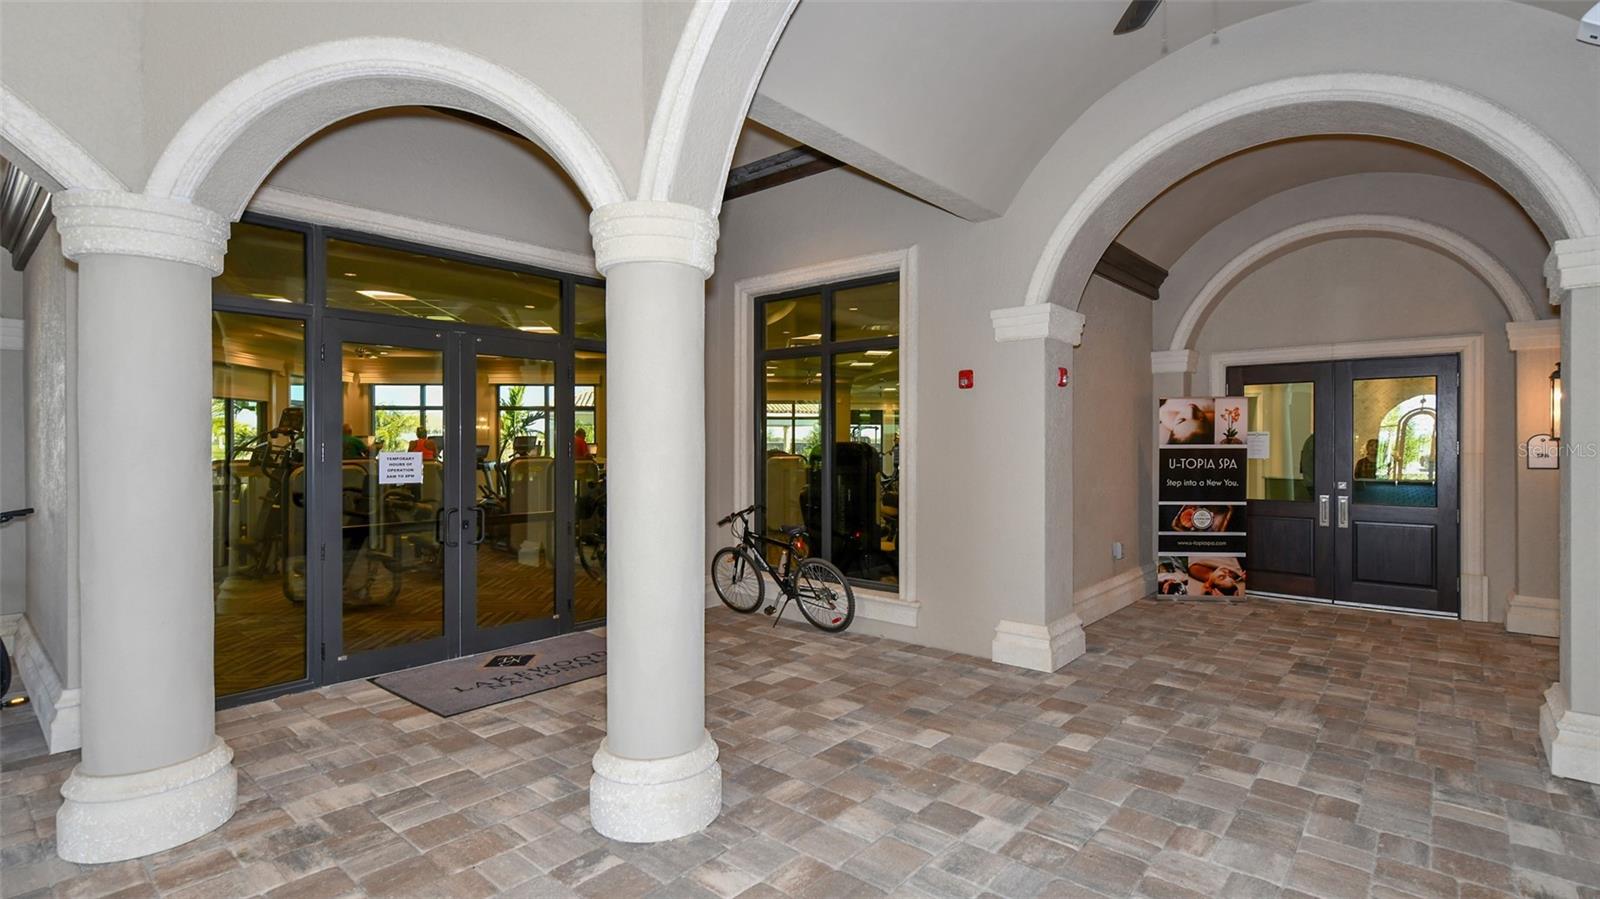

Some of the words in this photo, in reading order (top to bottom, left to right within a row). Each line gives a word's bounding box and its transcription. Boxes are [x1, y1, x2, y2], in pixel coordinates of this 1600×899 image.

[1168, 457, 1216, 470] U-TOPIA
[1218, 457, 1238, 470] SPA
[1166, 478, 1182, 488] Step
[1183, 479, 1198, 487] into
[1206, 479, 1223, 487] New
[1224, 479, 1239, 487] You.
